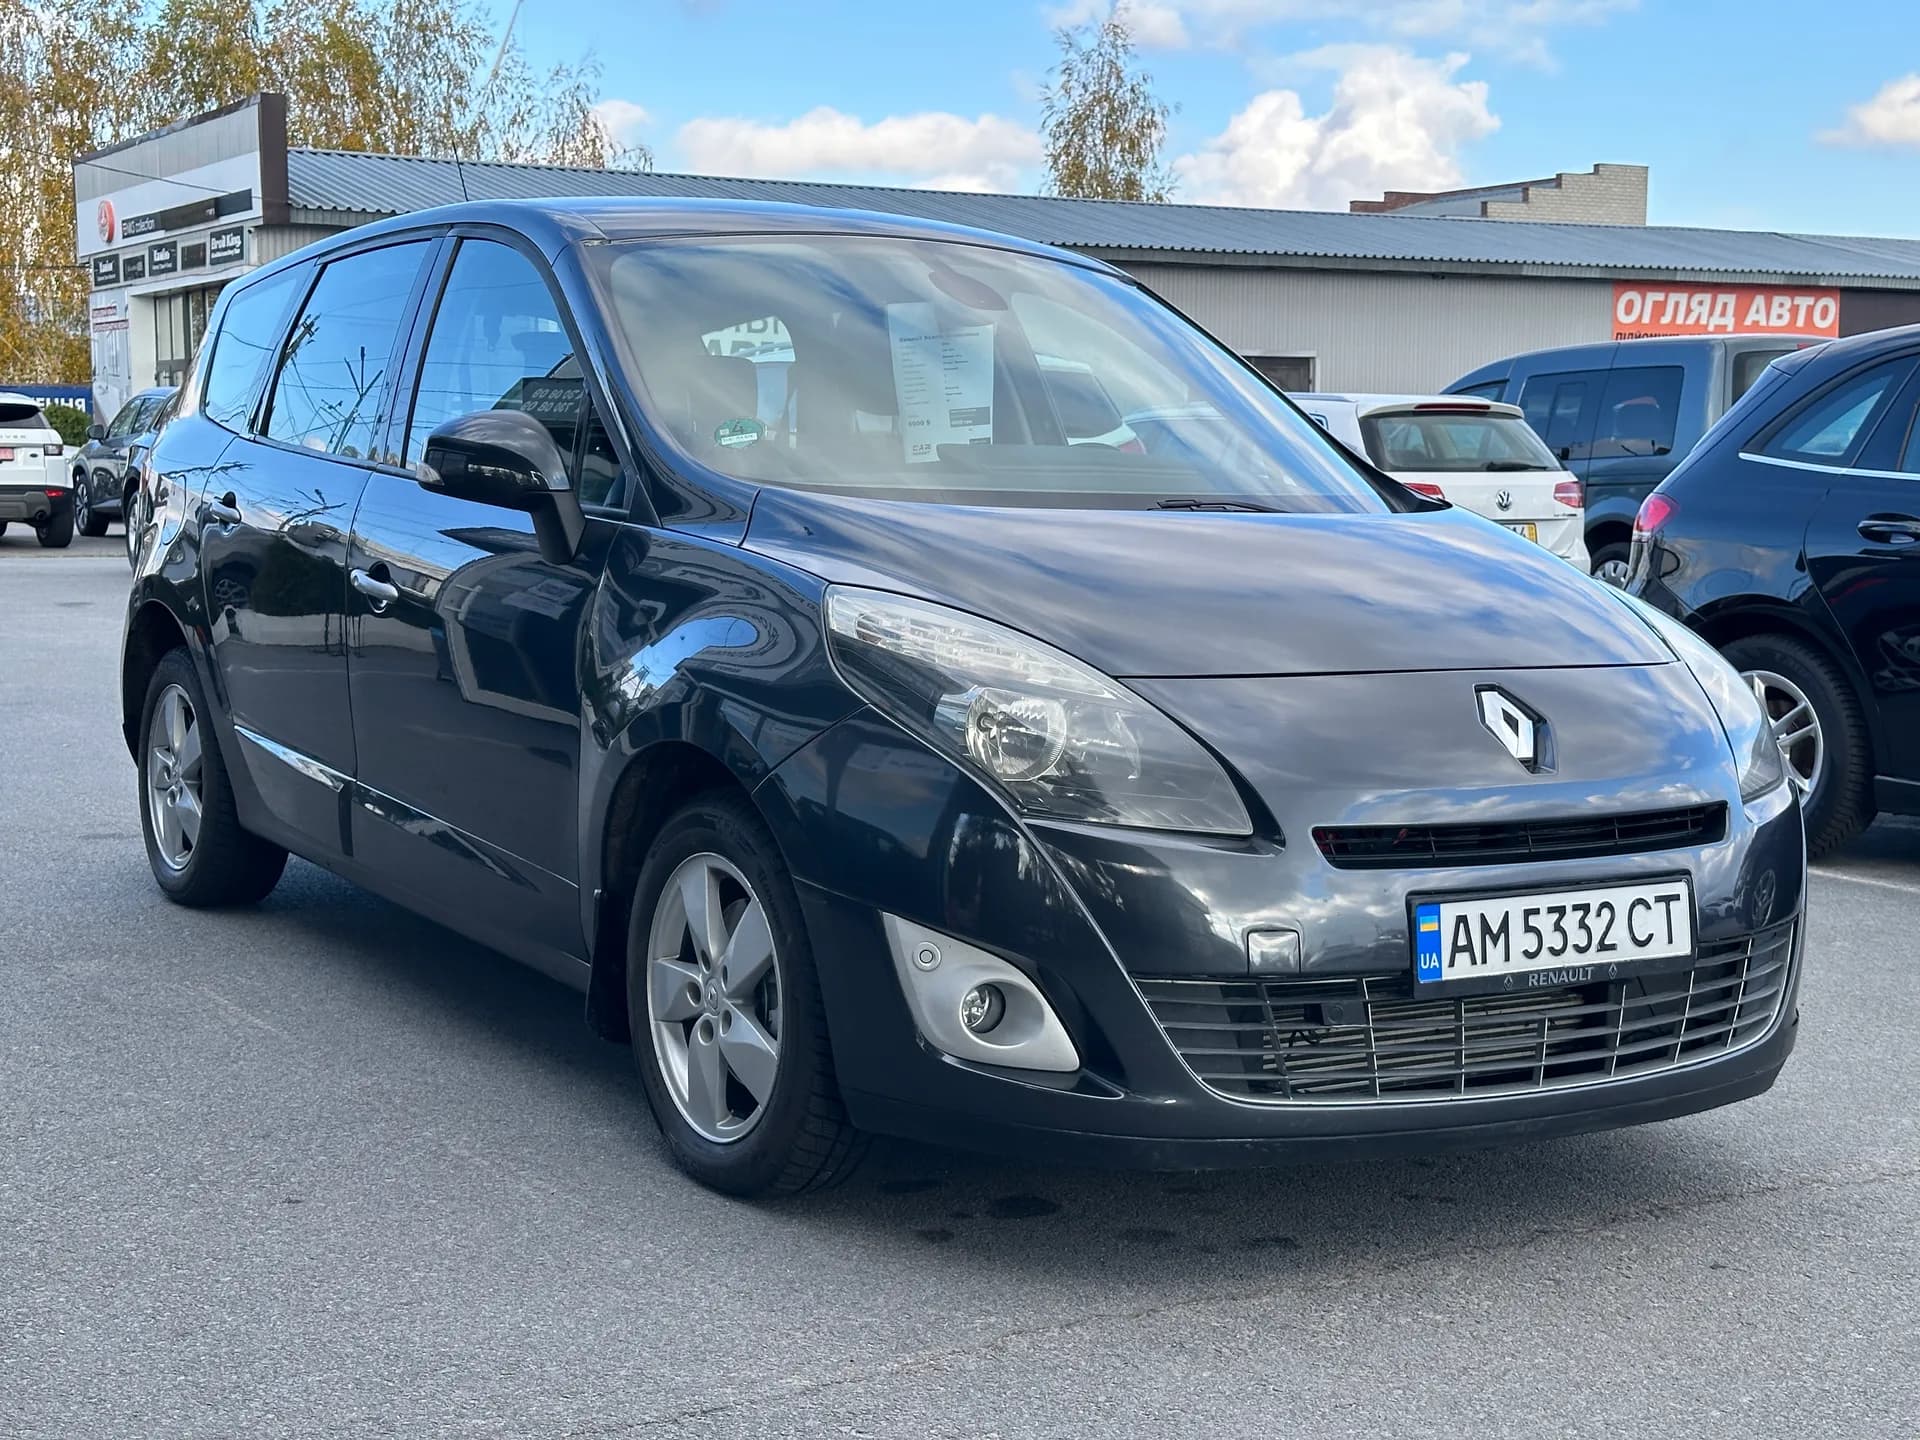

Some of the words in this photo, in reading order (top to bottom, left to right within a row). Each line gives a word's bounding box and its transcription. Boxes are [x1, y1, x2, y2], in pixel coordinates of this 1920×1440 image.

[1616, 290, 1737, 332] ОГЛЯД
[1743, 294, 1837, 329] АВТО
[1448, 911, 1510, 968] AM
[1522, 901, 1618, 959] 5332
[1627, 893, 1681, 948] CT
[1420, 951, 1440, 969] UA
[1528, 966, 1594, 987] RENAULT
